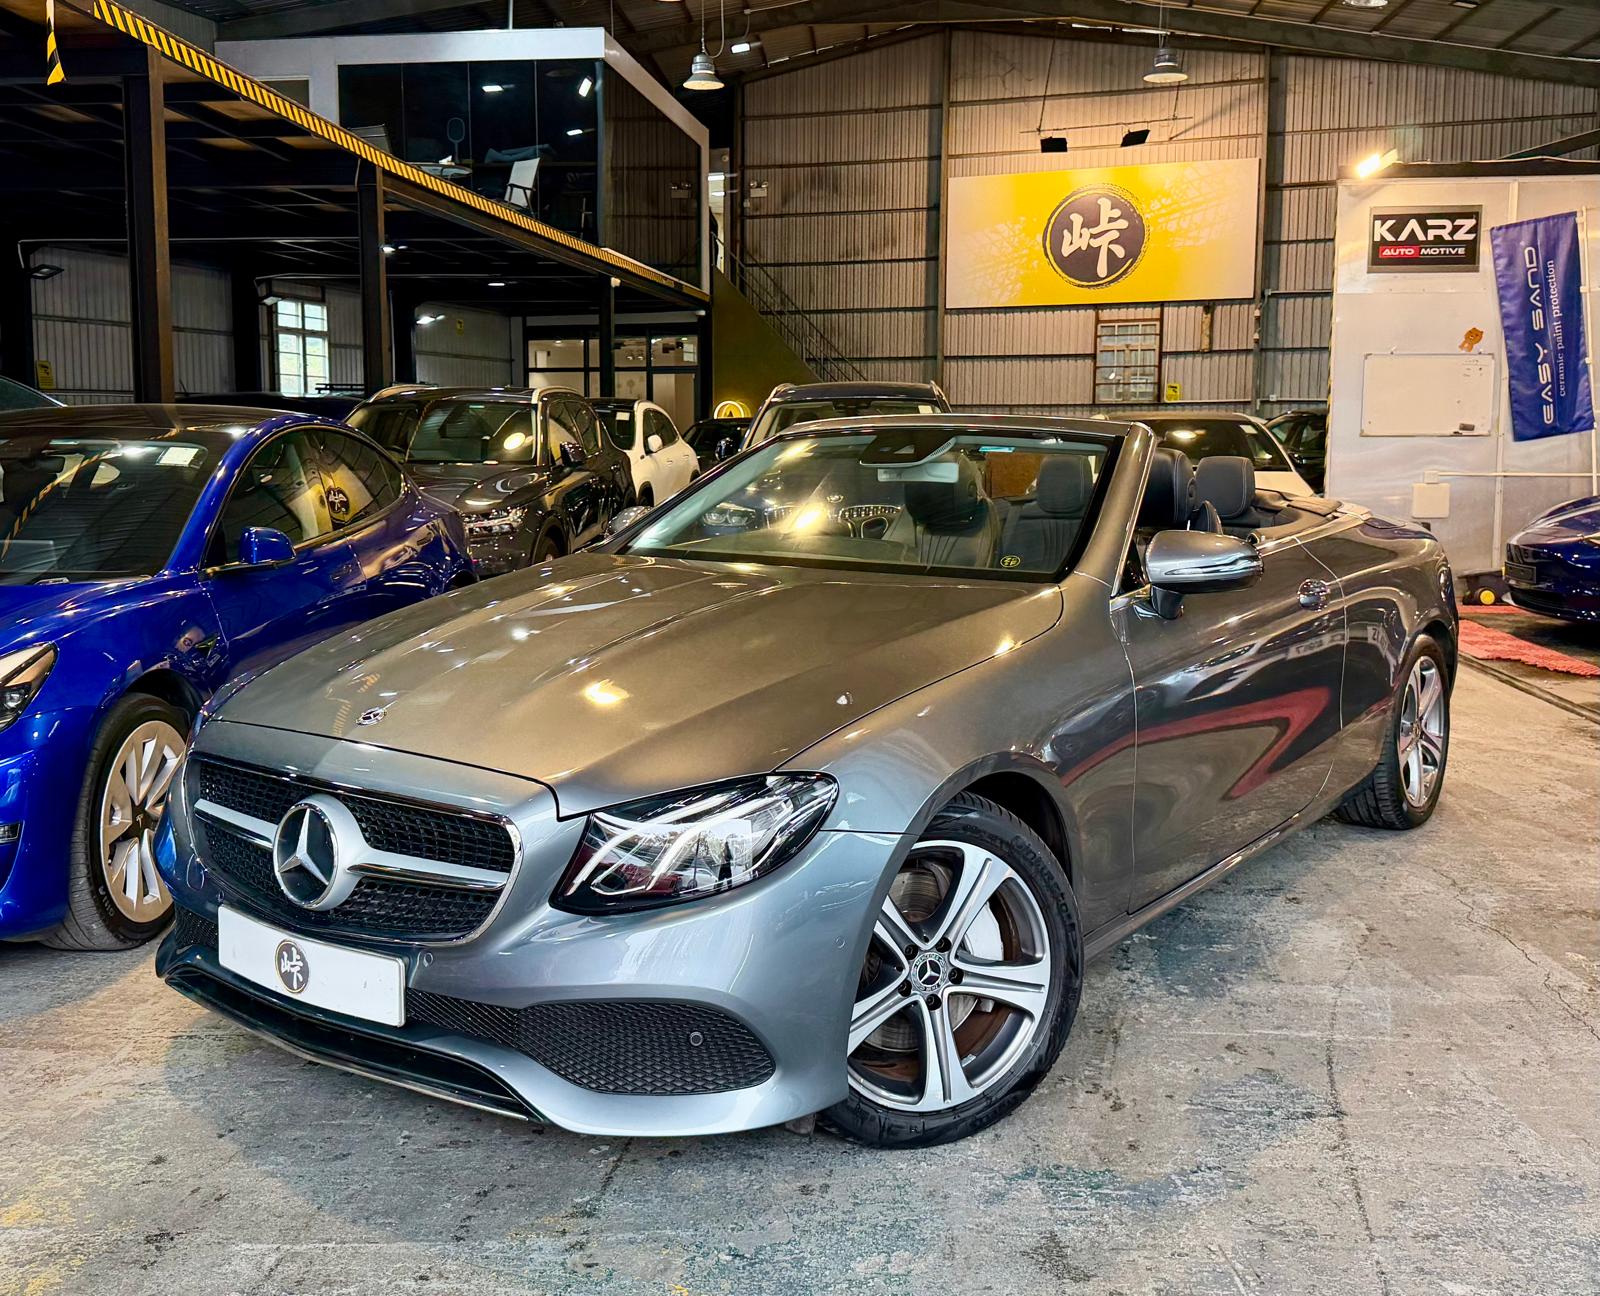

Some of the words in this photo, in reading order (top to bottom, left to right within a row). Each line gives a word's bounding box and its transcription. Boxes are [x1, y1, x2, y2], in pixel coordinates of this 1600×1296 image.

[1061, 198, 1129, 278] 峠
[1373, 218, 1477, 242] KARZ
[1382, 248, 1415, 256] AUTO
[1420, 247, 1466, 255] MOTIVE
[1524, 246, 1544, 331] SAND
[1546, 260, 1563, 317] protection
[1552, 320, 1565, 350] paint
[1535, 342, 1555, 425] EASY
[1557, 352, 1566, 397] ceramic
[281, 946, 304, 990] 峠
